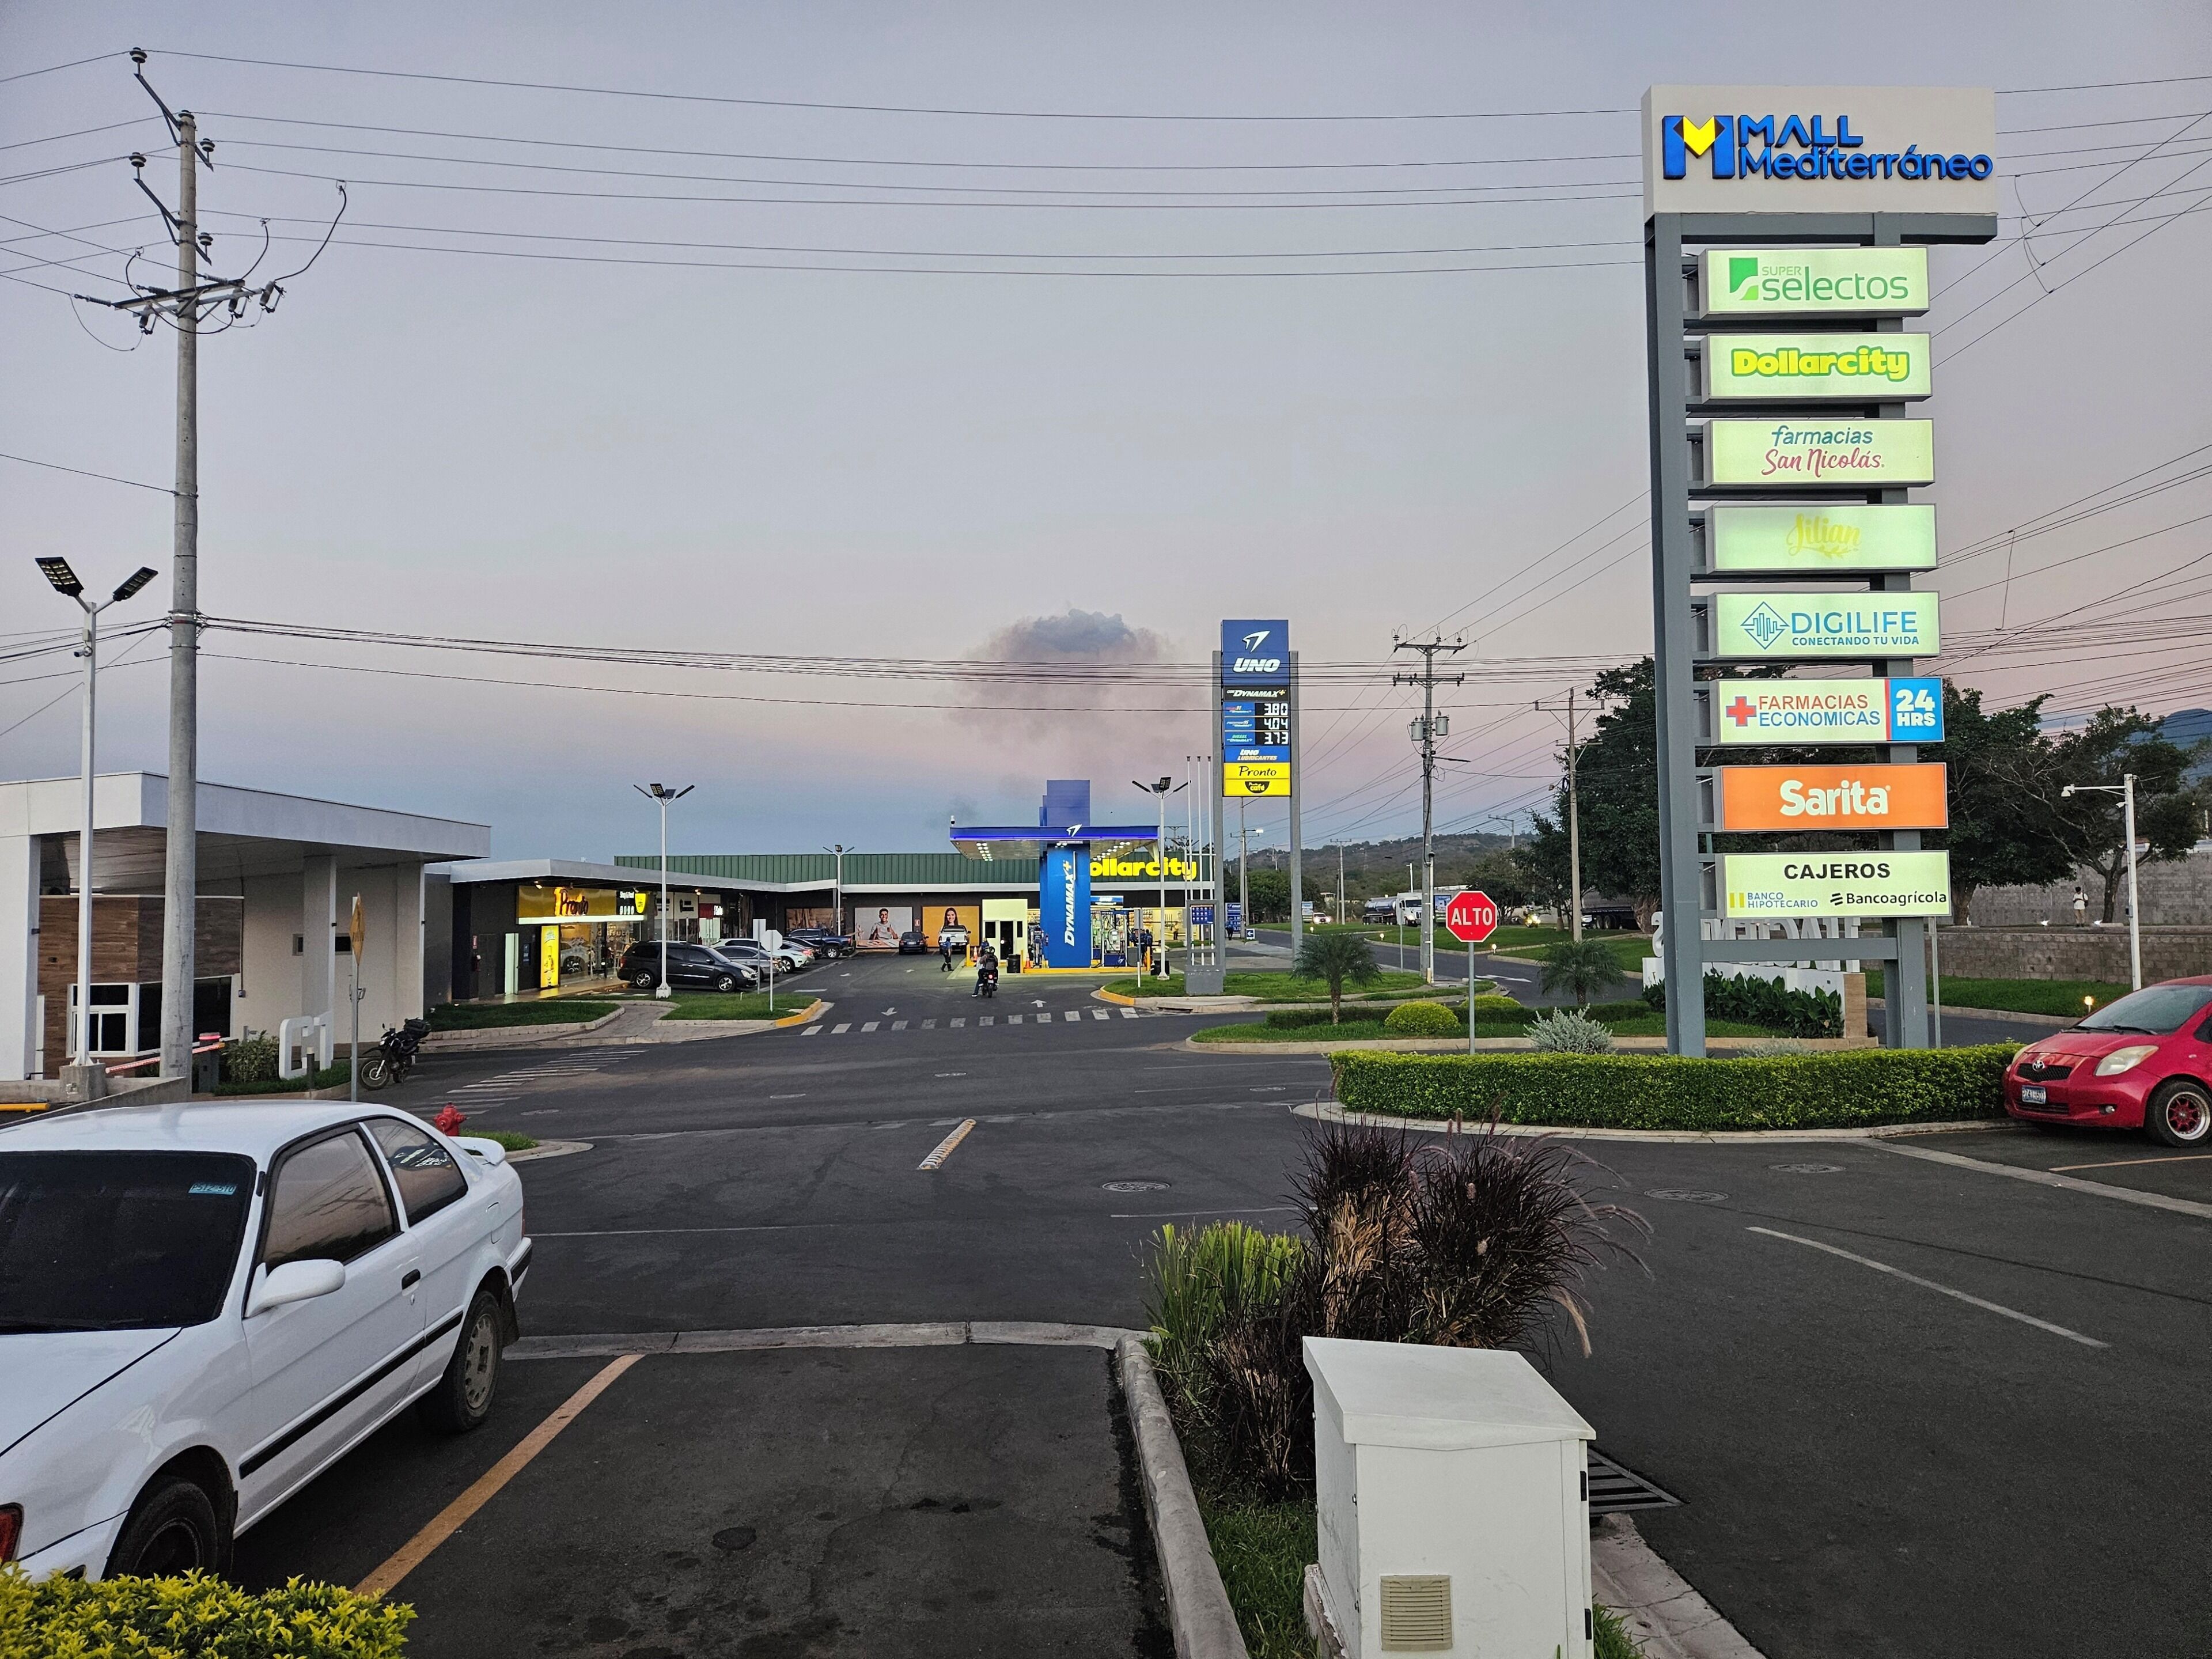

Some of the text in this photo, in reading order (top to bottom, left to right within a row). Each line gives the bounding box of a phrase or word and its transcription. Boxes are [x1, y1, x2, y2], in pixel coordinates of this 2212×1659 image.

[1738, 115, 1863, 148] MALL
[1738, 145, 1994, 181] Mediterráneo
[1762, 266, 1802, 276] SUPER
[1763, 266, 1908, 301] selectos
[1732, 345, 1910, 382] Dollarcity
[1771, 425, 1873, 447] farmacias
[1761, 447, 1883, 478] San Nicolás
[1791, 611, 1918, 634] DIGILIFE
[1792, 636, 1919, 646] CONECTANDO TU VIDA
[1233, 657, 1281, 673] UNO
[1759, 695, 1868, 710] FARMACIAS
[1896, 689, 1936, 711] 24
[1759, 710, 1881, 726] ECONOMICAS
[1896, 712, 1936, 727] HRS
[1238, 766, 1277, 777] Pronto
[1780, 779, 1889, 816] Sarita
[1090, 857, 1196, 881] ollarcity
[1784, 863, 1891, 880] CAJEROS
[1748, 892, 1784, 900] BANCO
[1748, 900, 1819, 908] HIPOTECARIO
[1846, 891, 1946, 907] Bancoagrícola
[1450, 907, 1493, 926] ALTO
